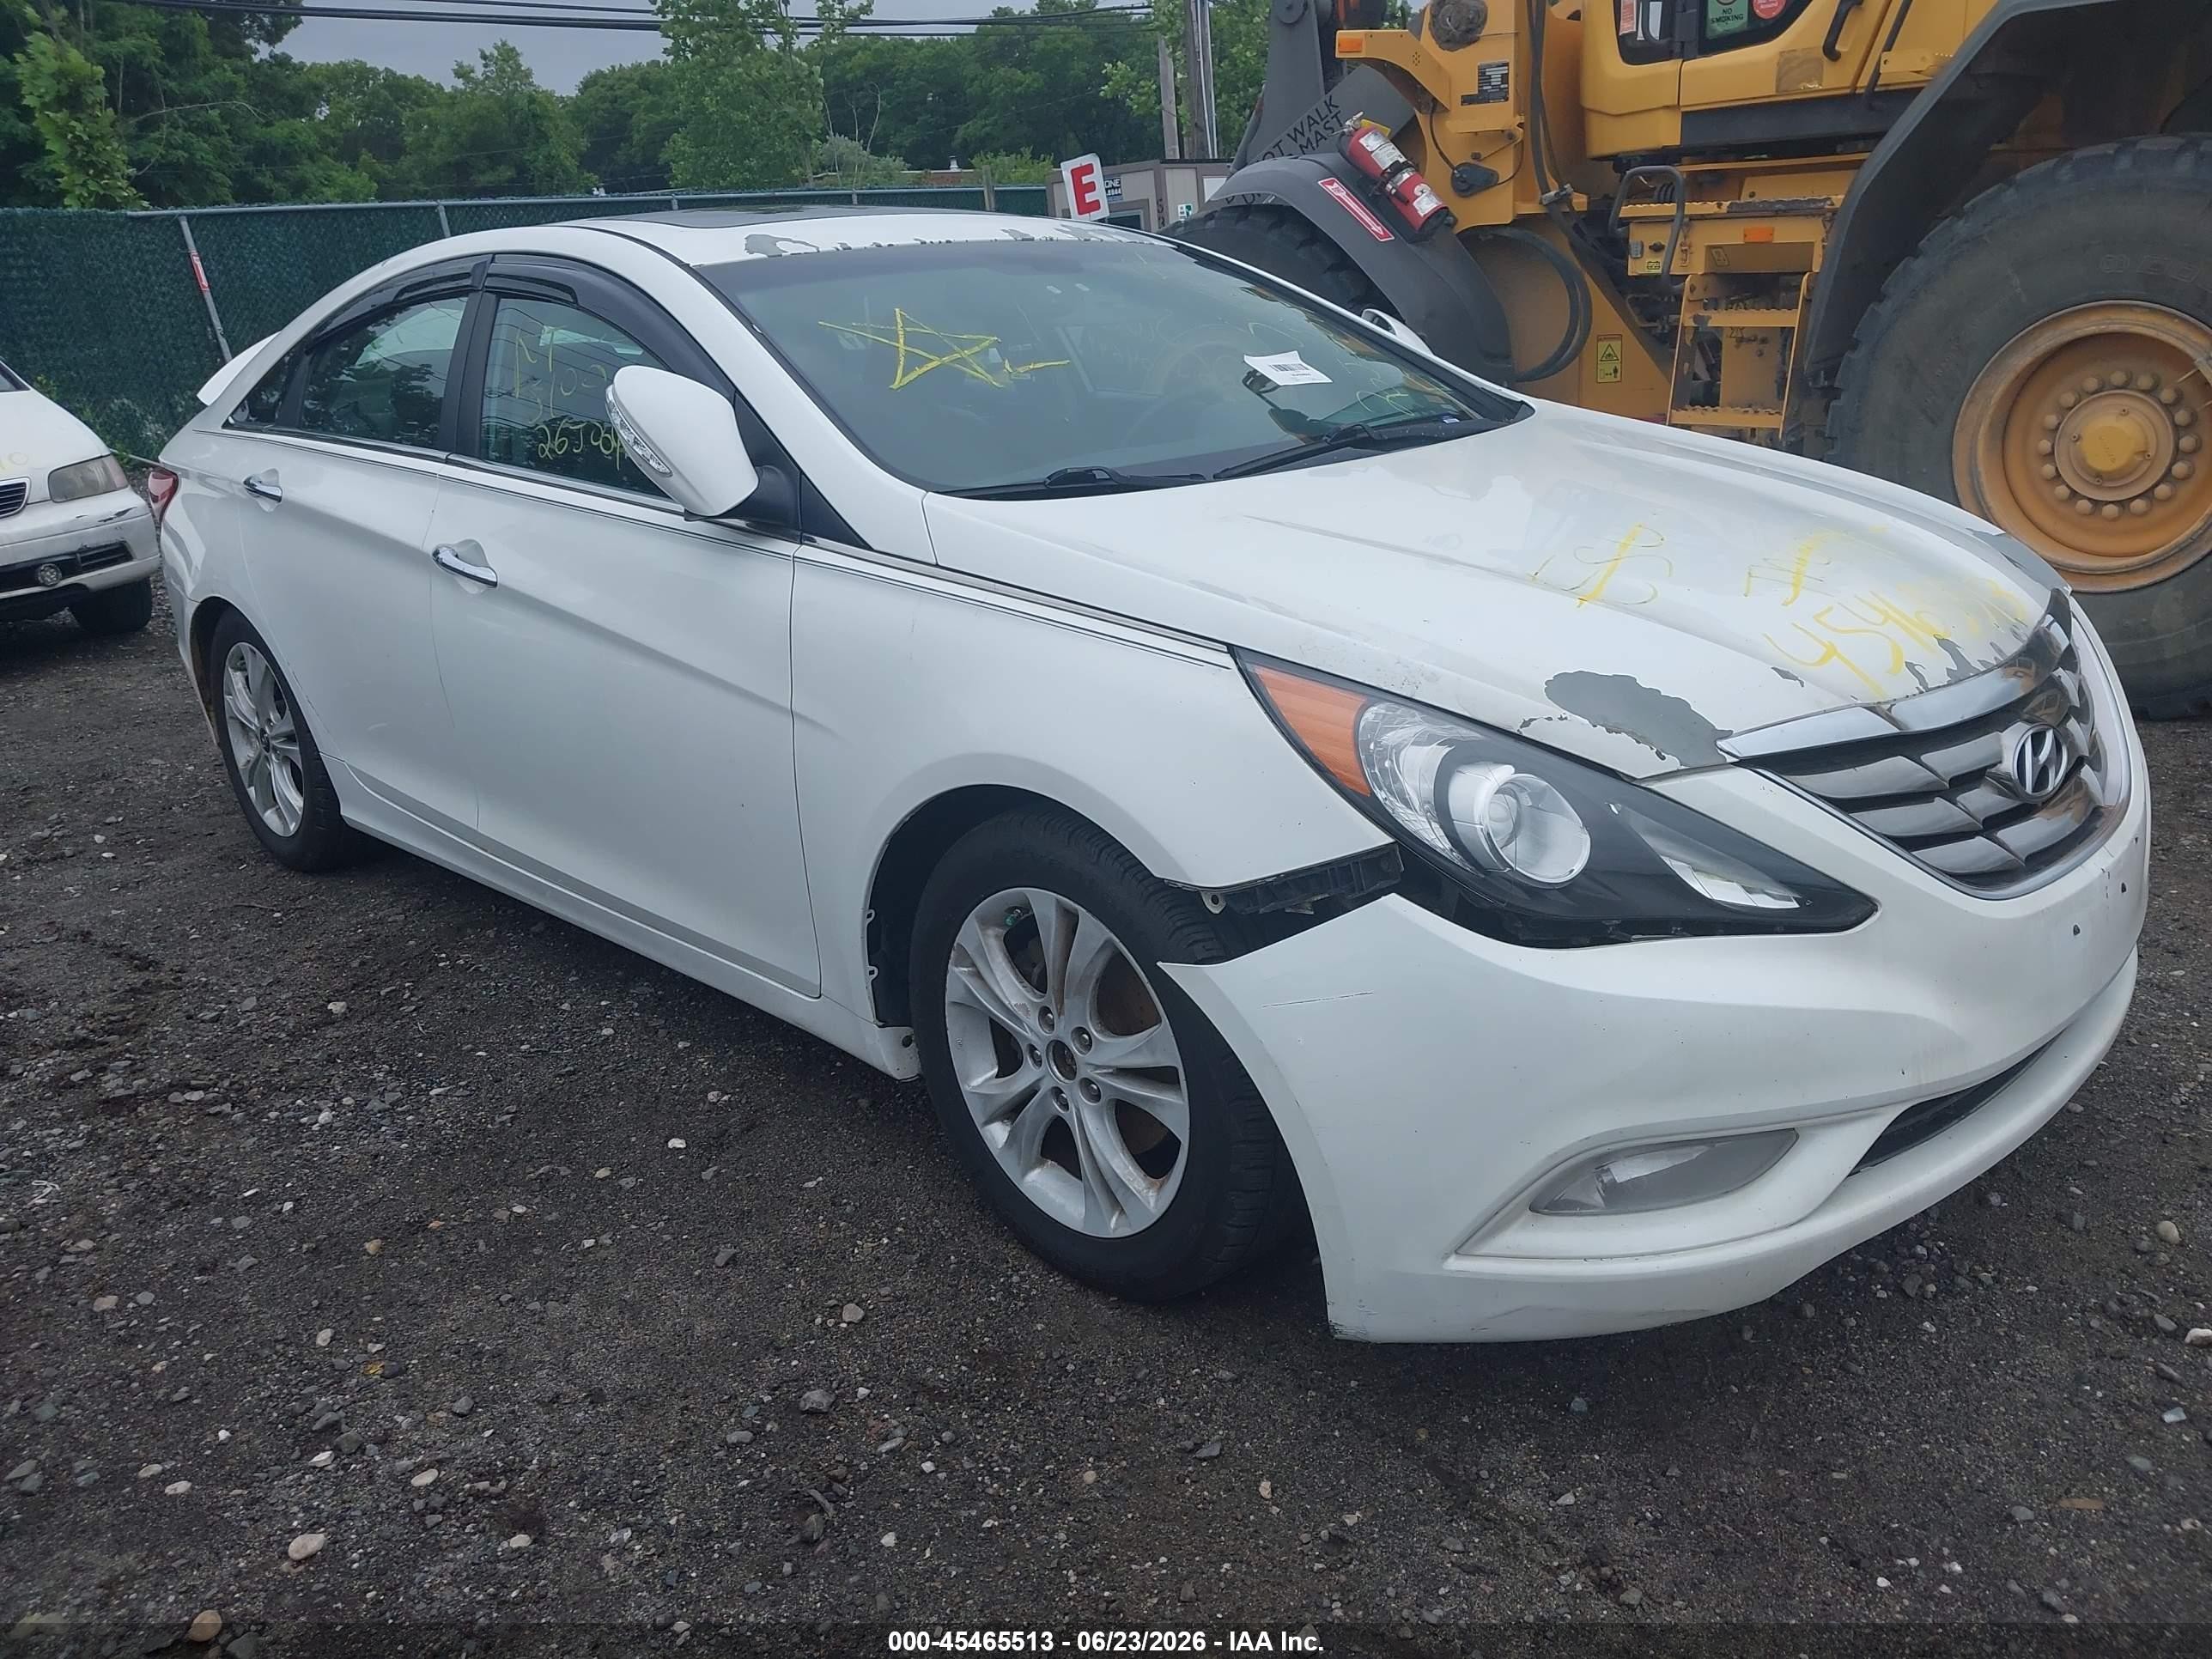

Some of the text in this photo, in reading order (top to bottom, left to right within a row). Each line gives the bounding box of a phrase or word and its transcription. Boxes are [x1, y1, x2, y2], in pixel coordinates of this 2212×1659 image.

[1711, 13, 1744, 24] SMOKING
[1286, 94, 1340, 144] WALK
[1298, 110, 1344, 155] MAST
[1070, 162, 1102, 216] E
